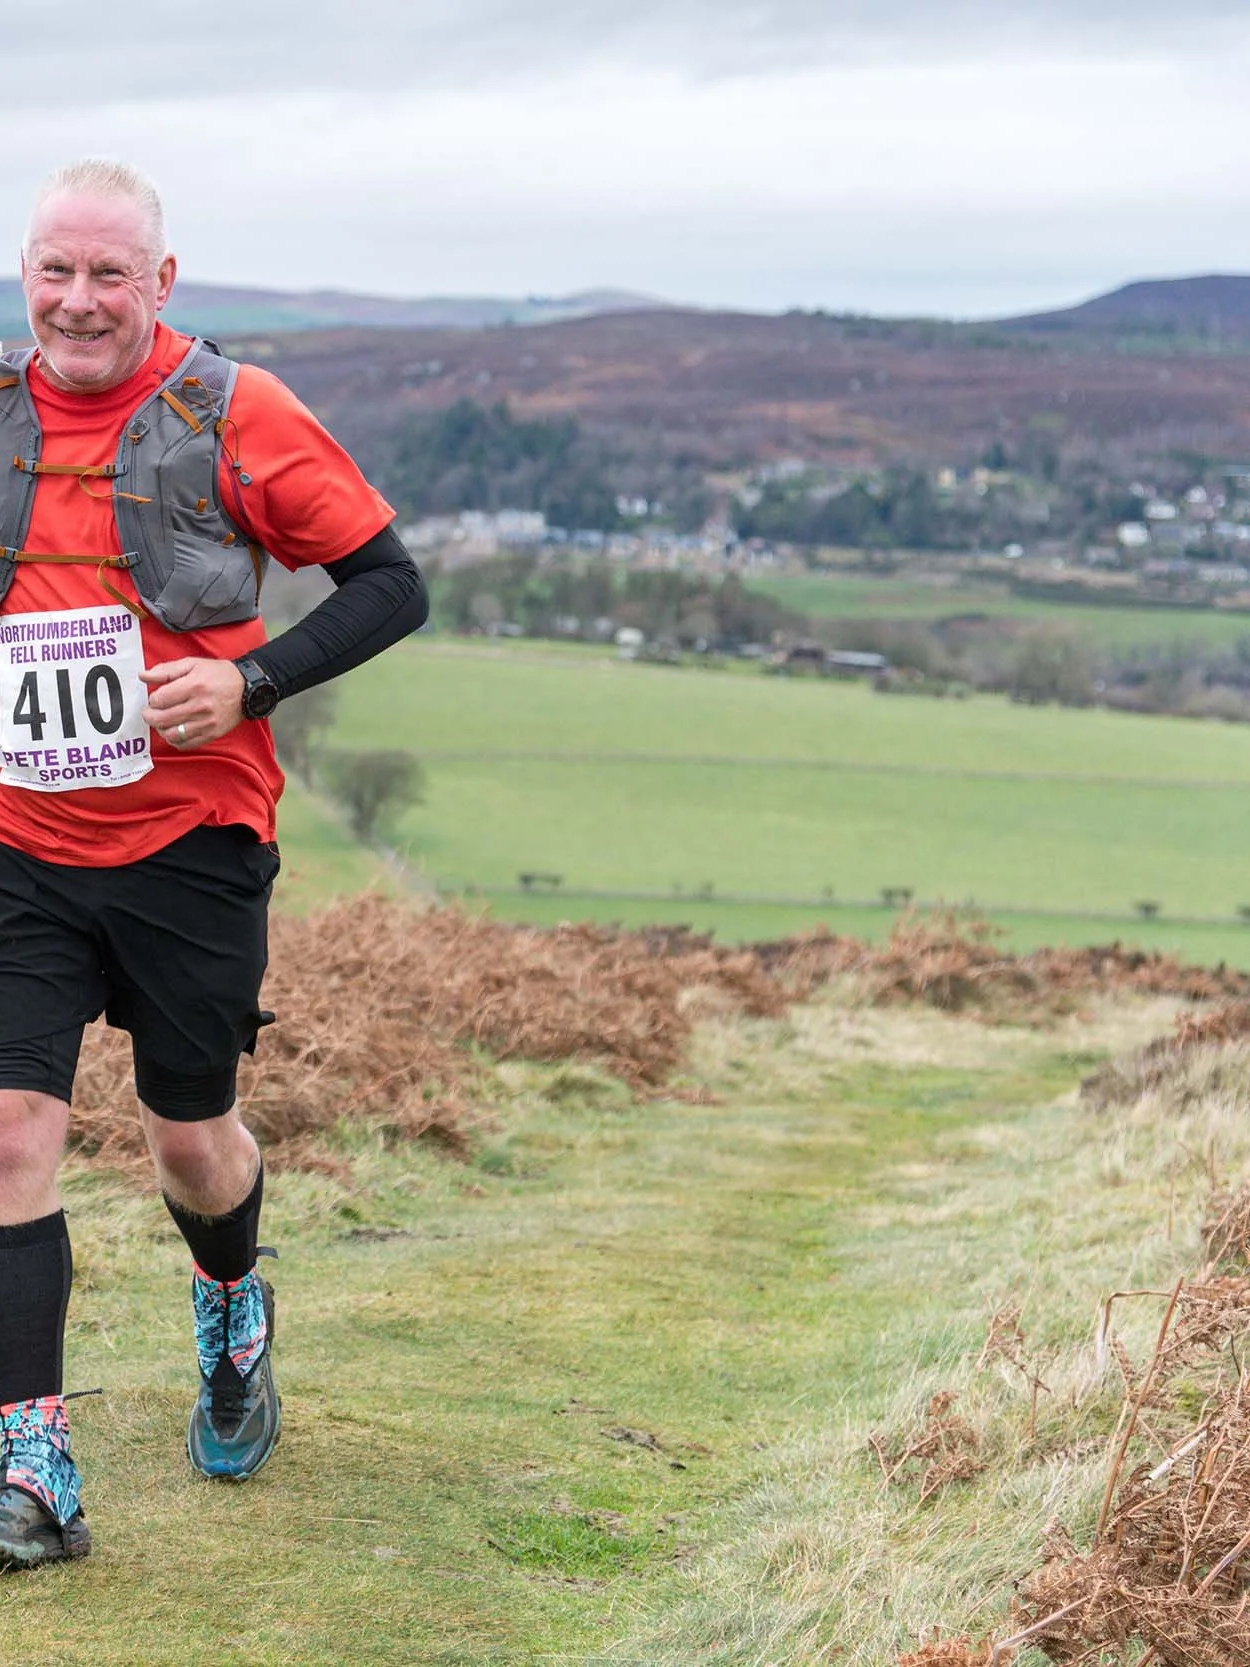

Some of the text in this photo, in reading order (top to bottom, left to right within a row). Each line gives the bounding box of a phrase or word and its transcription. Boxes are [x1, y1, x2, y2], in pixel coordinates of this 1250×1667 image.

[10, 638, 117, 664] FELL RUNNERS
[13, 664, 124, 741] 410
[2, 737, 146, 767] PETE BLAND
[38, 764, 112, 782] SPORTS
